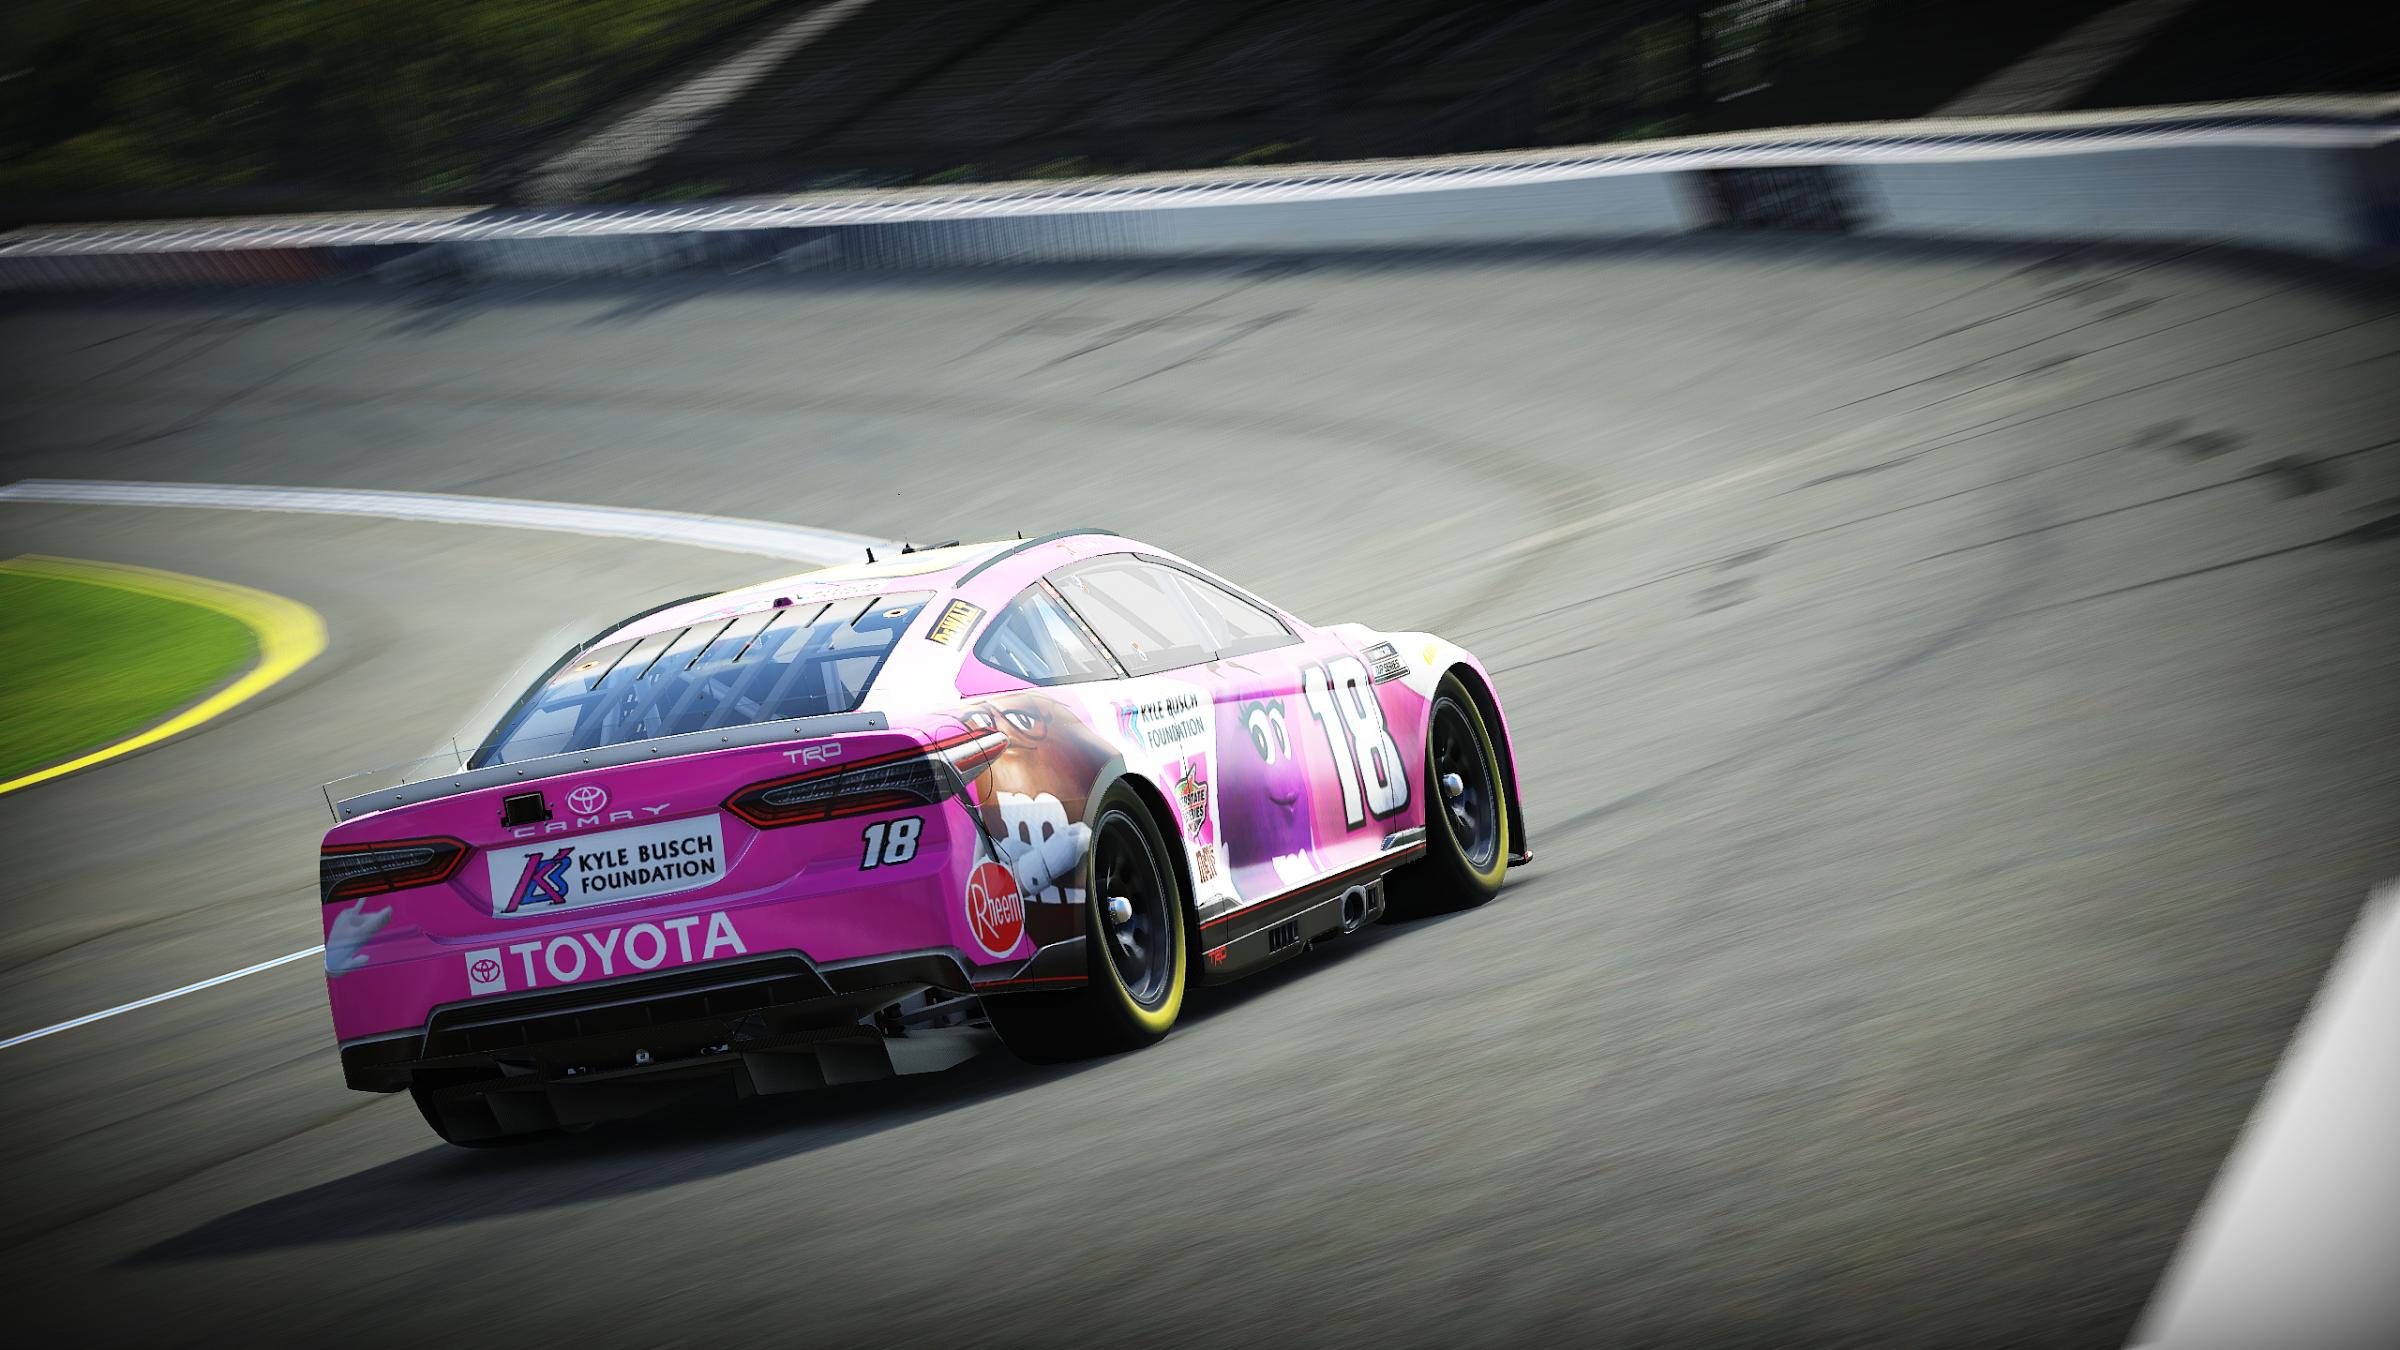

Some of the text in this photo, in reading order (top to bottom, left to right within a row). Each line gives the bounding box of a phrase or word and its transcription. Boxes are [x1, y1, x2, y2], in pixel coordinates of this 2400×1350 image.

[1141, 693, 1198, 722] KYLE BUSCH
[1147, 716, 1205, 748] FOUNDATION
[1301, 656, 1410, 832] 18
[783, 742, 842, 765] TRD
[514, 803, 670, 838] CAMRY
[579, 835, 713, 872] KYLE BUSCH
[858, 816, 925, 871] 18
[582, 858, 715, 894] FOUNDATION
[971, 866, 1022, 939] Rheem
[510, 911, 748, 987] TOYOTA
